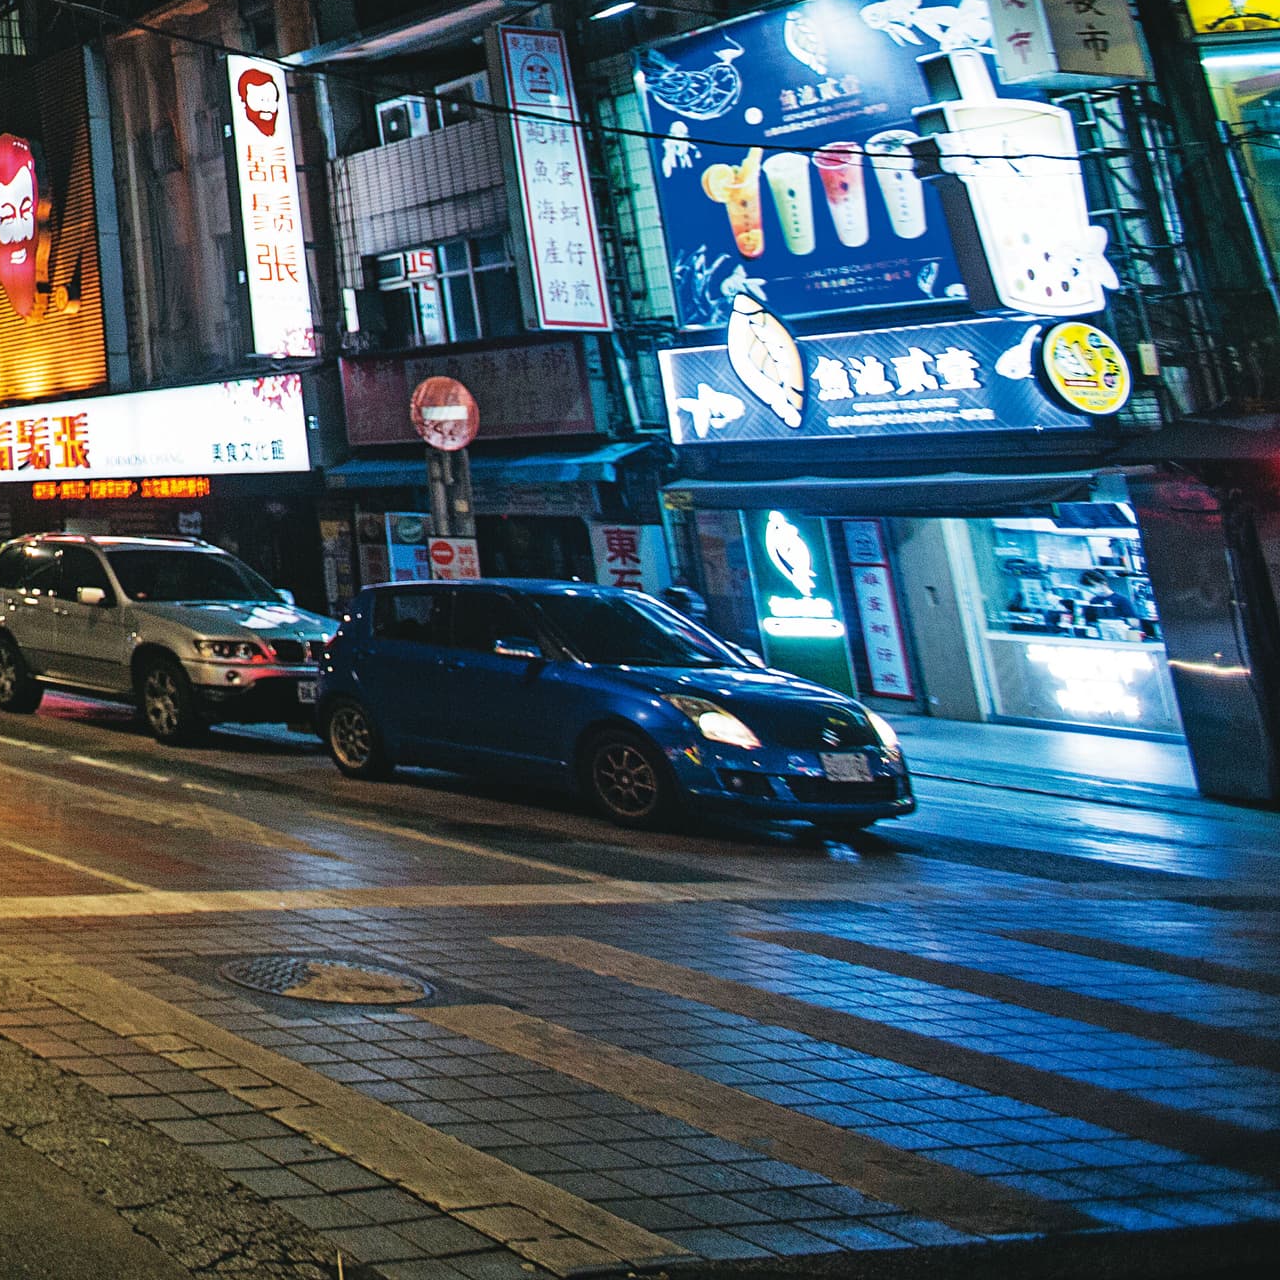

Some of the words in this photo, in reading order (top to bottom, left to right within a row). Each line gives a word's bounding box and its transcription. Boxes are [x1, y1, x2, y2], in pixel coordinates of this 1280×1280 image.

[247, 144, 299, 283] 鬍鬚張
[211, 439, 286, 464] 美食文化館
